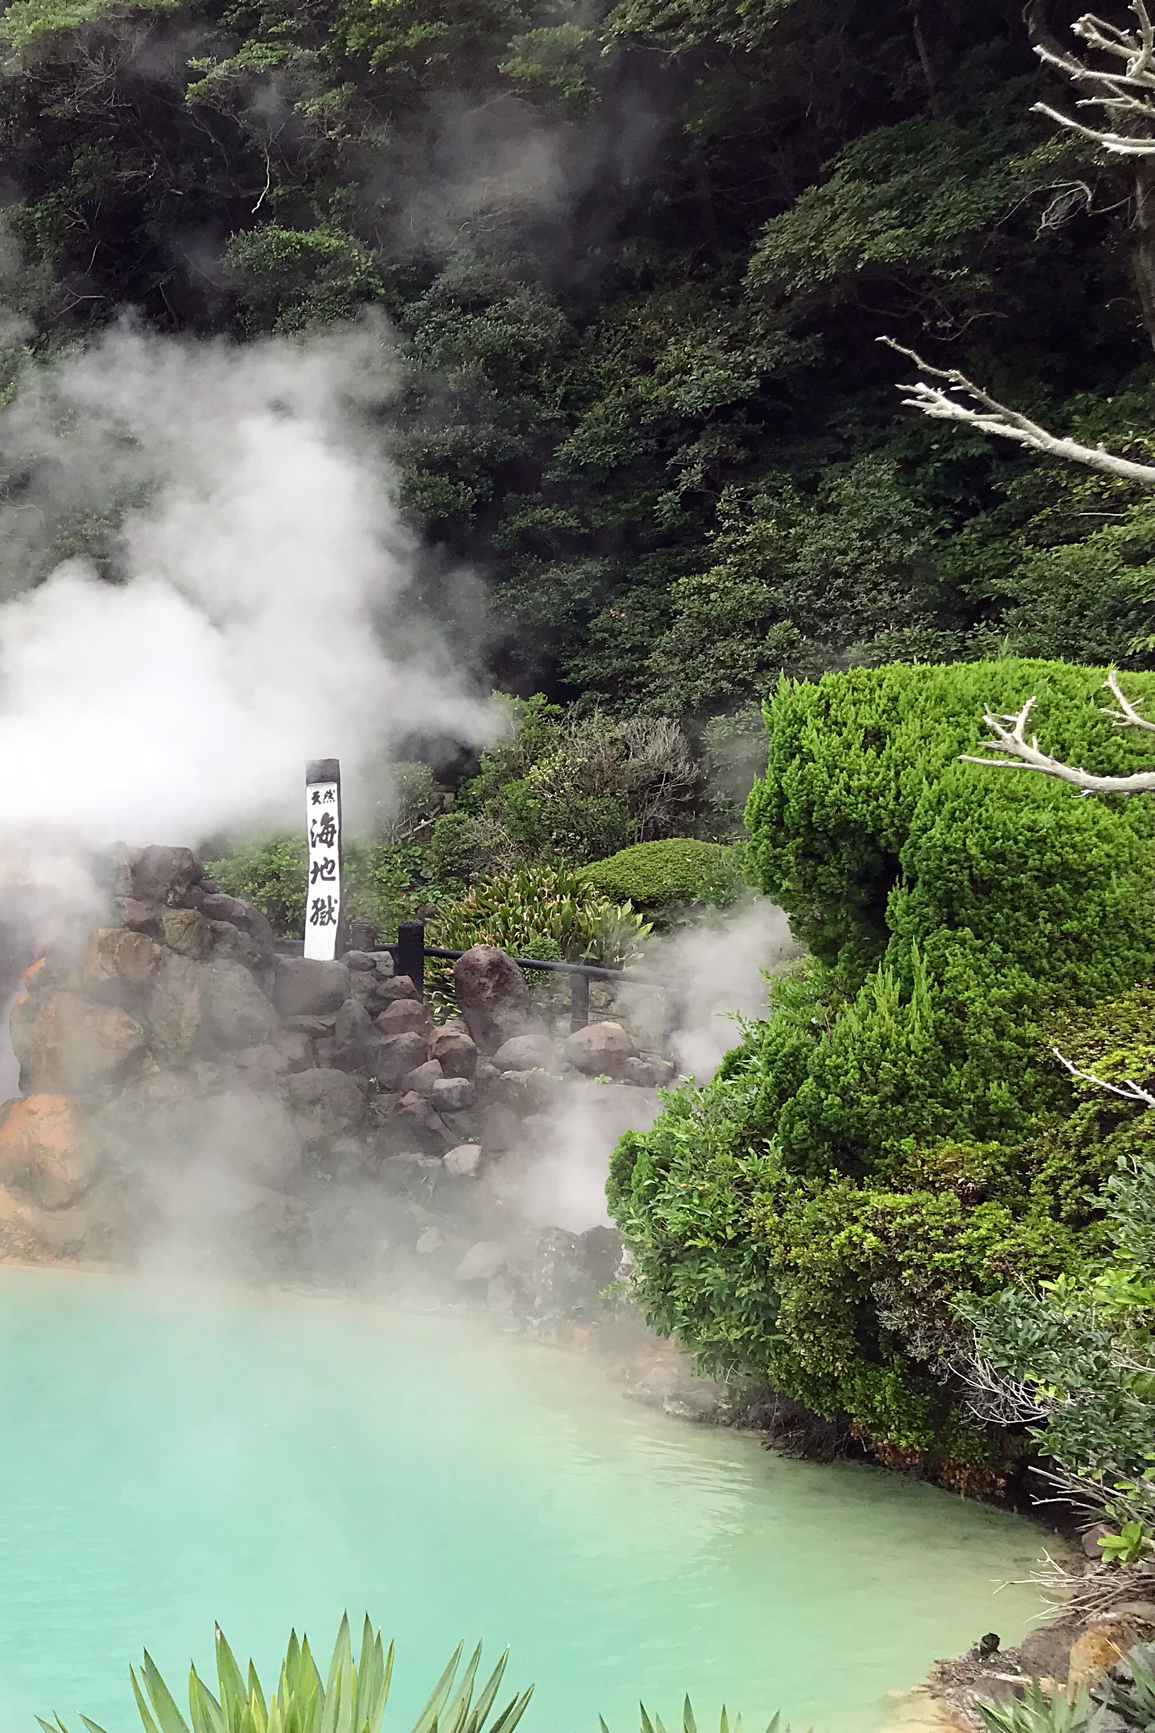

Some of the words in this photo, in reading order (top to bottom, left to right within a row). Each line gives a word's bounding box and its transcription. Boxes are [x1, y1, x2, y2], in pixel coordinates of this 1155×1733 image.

[311, 789, 336, 806] 天然
[309, 812, 337, 927] 海地獄
